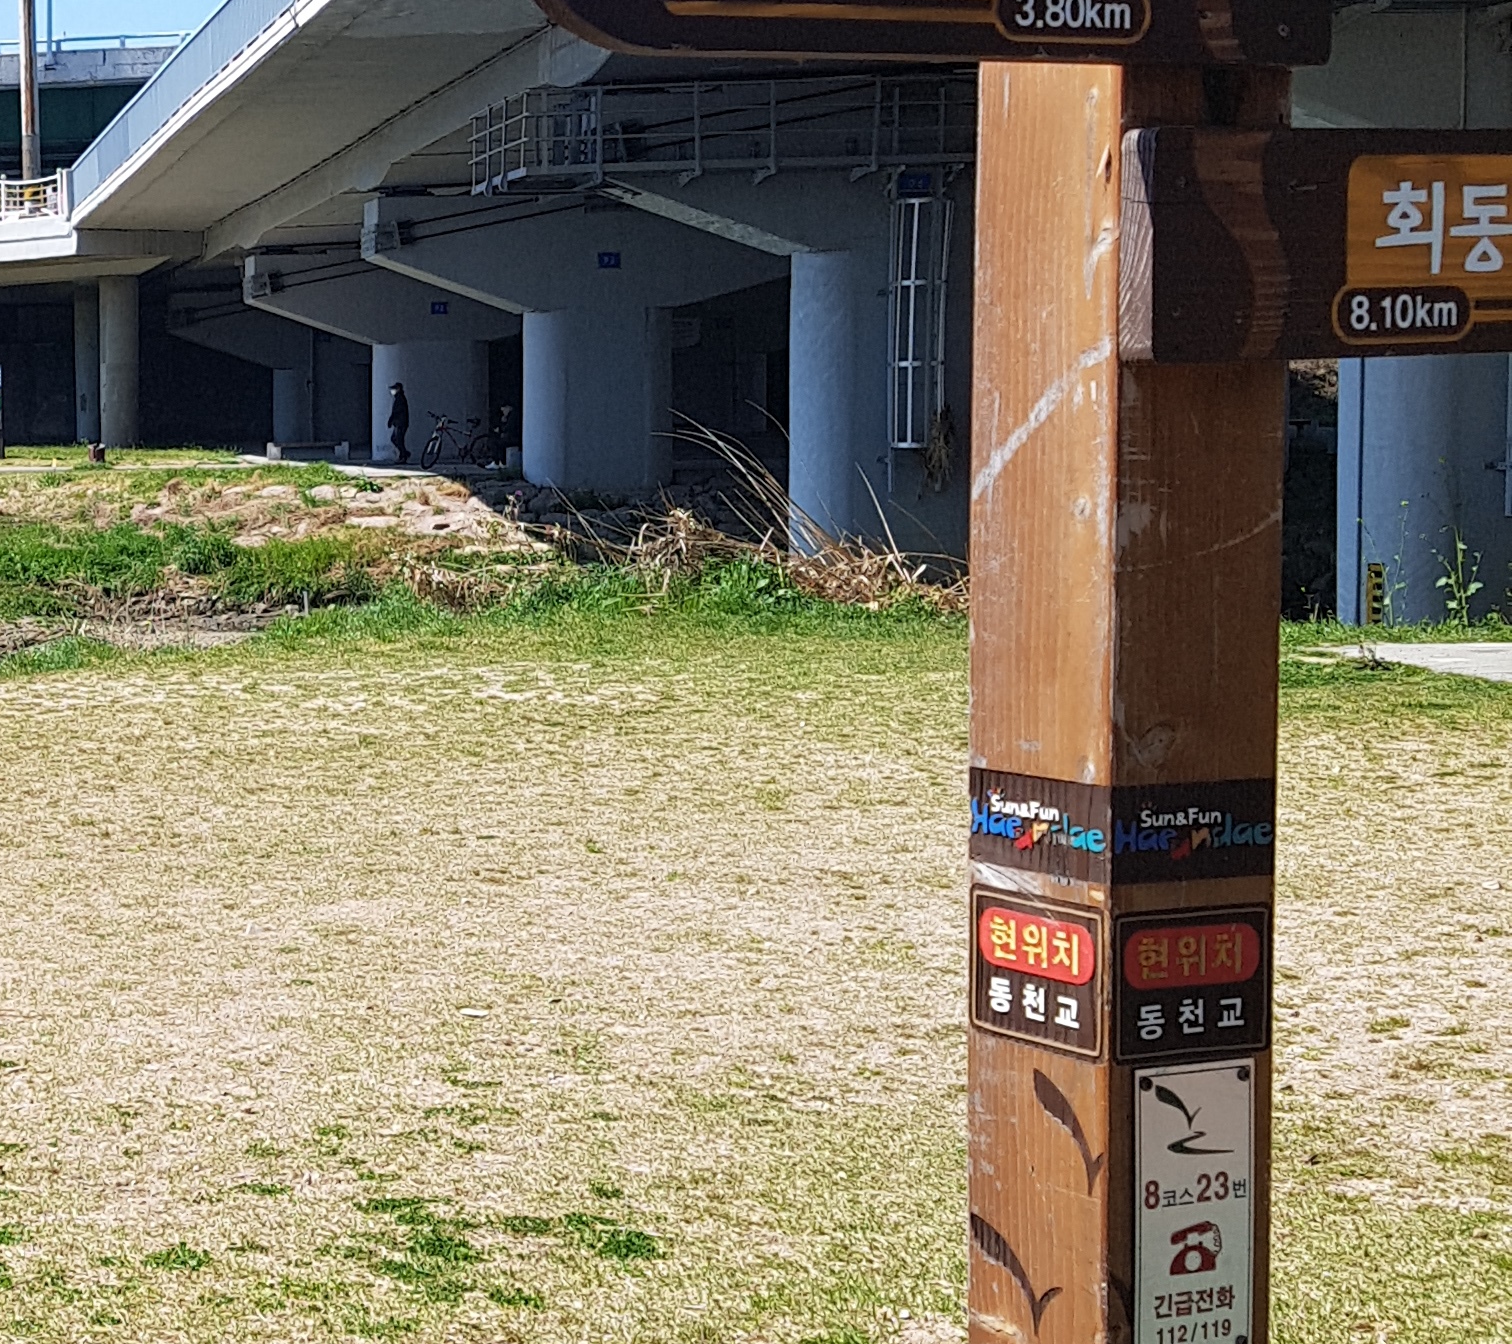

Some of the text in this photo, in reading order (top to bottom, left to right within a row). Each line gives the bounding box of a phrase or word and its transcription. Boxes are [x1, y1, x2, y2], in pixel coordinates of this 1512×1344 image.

[1350, 293, 1459, 332] 8.10km
[989, 794, 1061, 823] Sun&Fun
[1140, 807, 1223, 829] Sun&Fun
[990, 913, 1080, 976] 현위치
[1138, 929, 1244, 981] 현위치
[1153, 1284, 1236, 1320] 긴급전화
